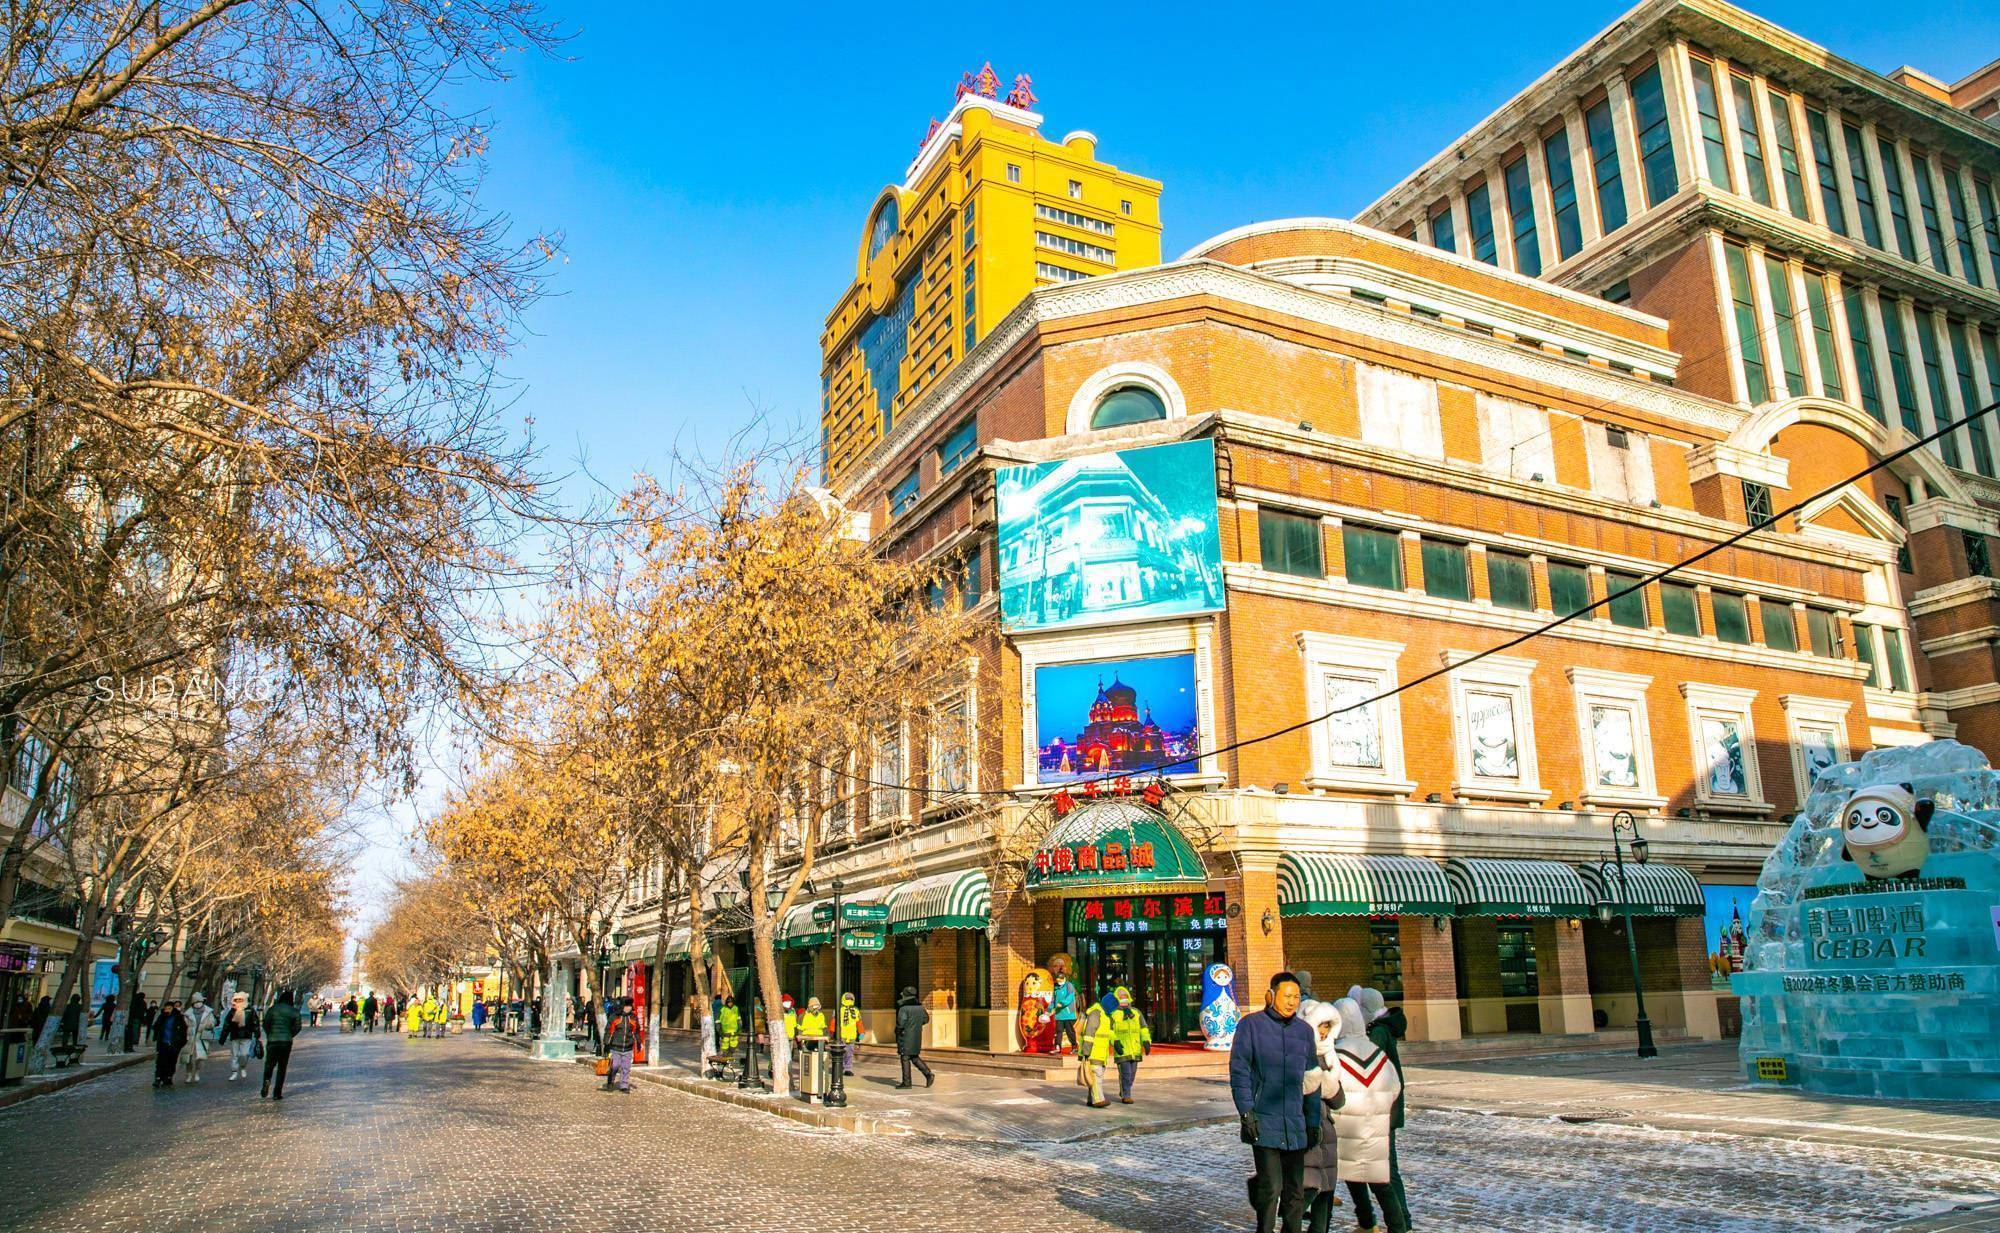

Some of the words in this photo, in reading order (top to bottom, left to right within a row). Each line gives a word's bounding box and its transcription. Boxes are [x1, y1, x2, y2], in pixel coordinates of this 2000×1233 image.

[1035, 842, 1155, 874] 中俄商品城
[1369, 903, 1403, 912] 俄罗斯特产
[1098, 921, 1148, 933] 进店购物
[1807, 905, 1925, 937] 青岛啤酒
